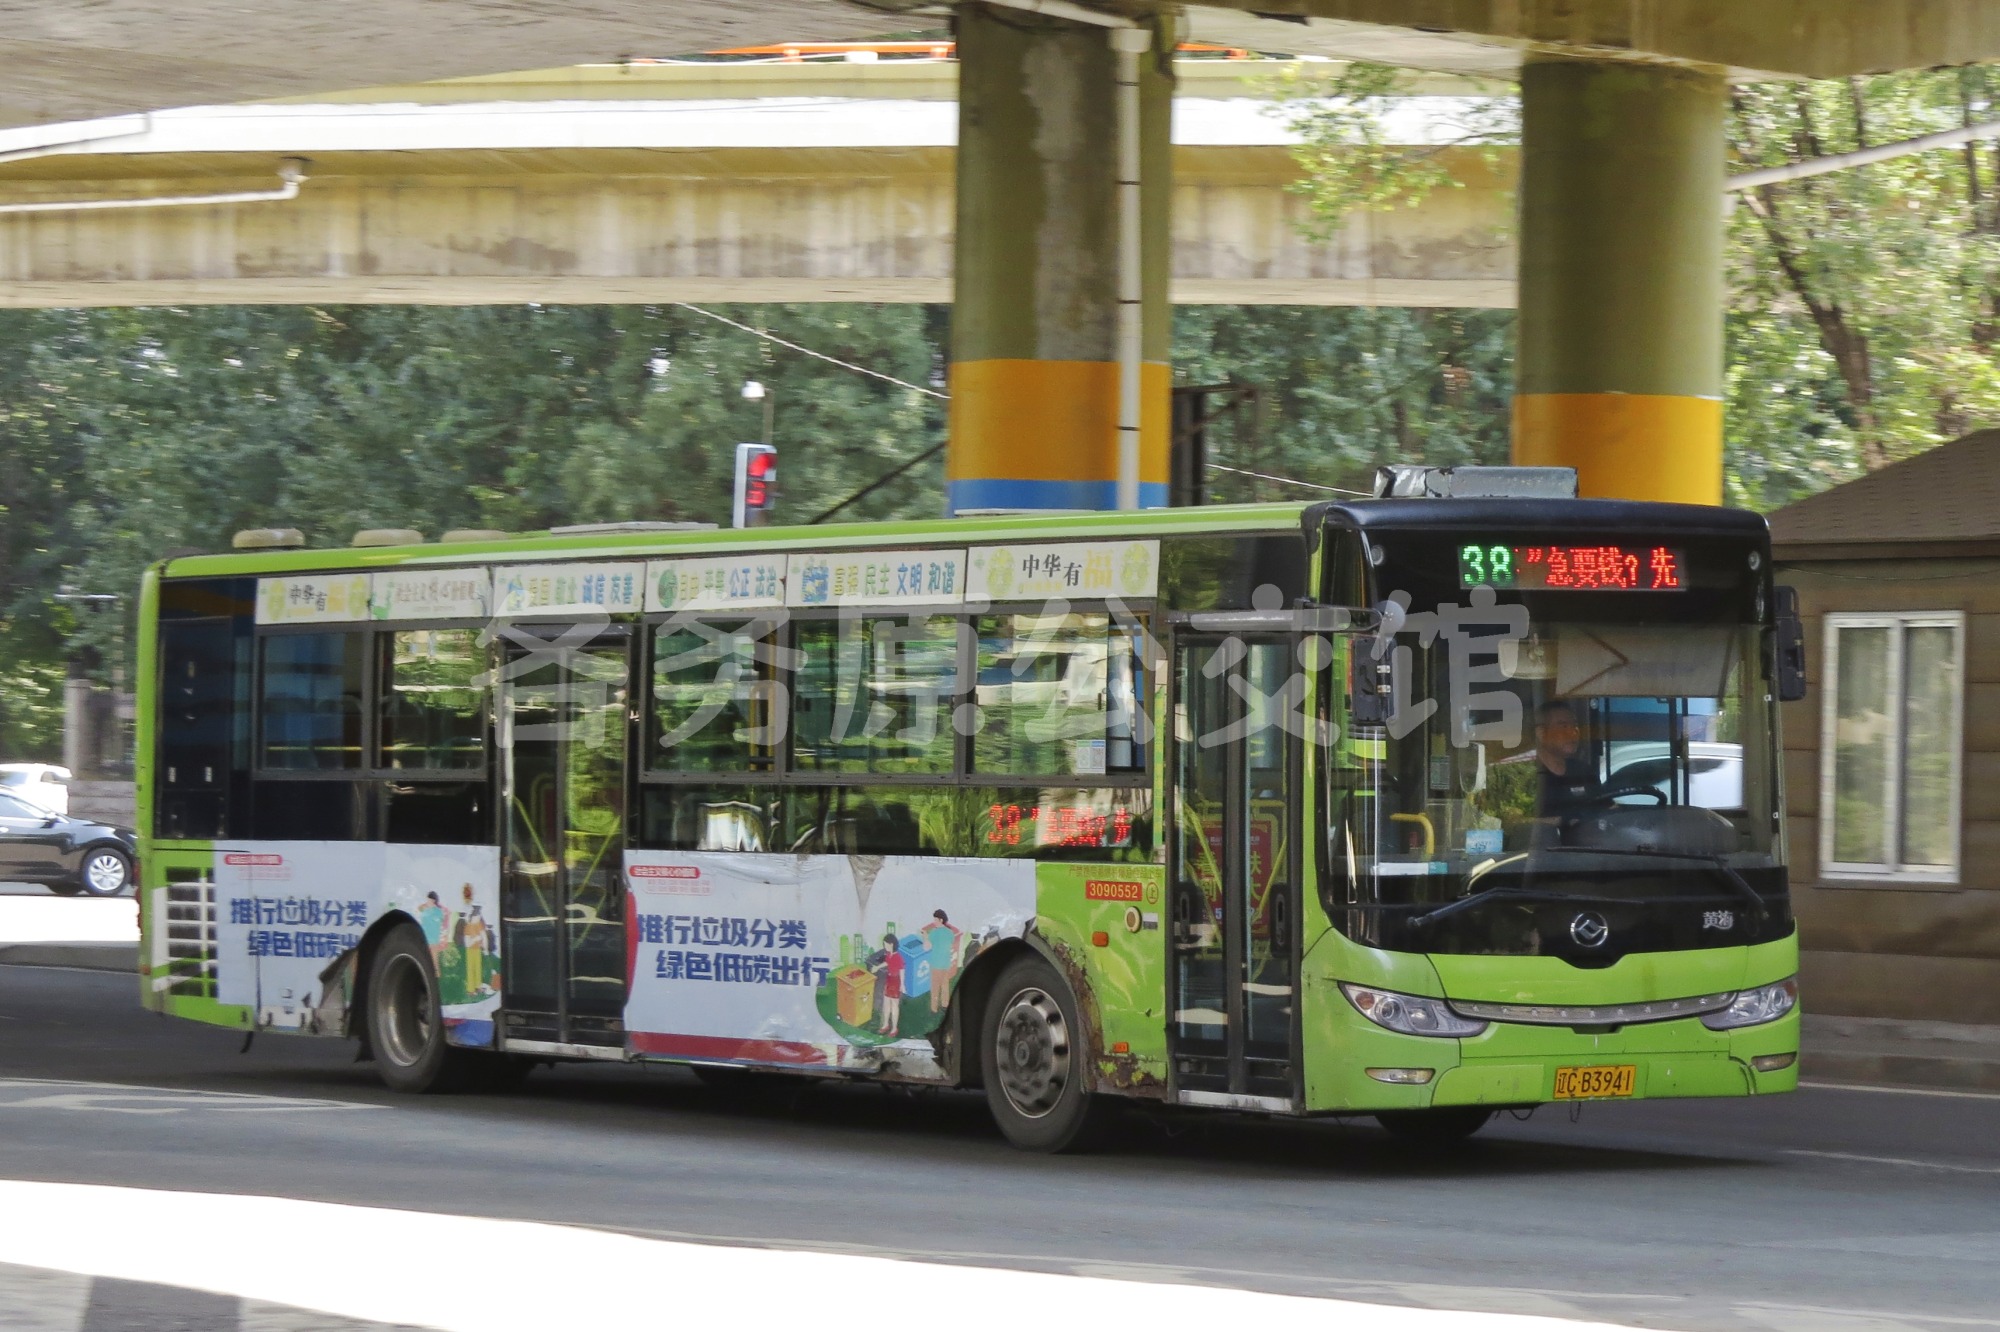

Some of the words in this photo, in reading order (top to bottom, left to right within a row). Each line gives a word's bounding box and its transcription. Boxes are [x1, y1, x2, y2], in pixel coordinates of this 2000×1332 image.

[729, 567, 751, 598] 公正
[865, 563, 890, 595] 民主
[896, 562, 923, 595] 文明
[928, 560, 956, 595] 和谐
[1022, 549, 1113, 589] 中华有福
[1463, 545, 1511, 585] 38
[1650, 547, 1678, 588] 先
[1089, 884, 1139, 899] 3090552
[230, 896, 368, 927] 推行垃圾分类
[1703, 909, 1734, 930] 黄海
[637, 914, 808, 949] 推行垃圾分类
[656, 949, 831, 987] 绿色低碳出行
